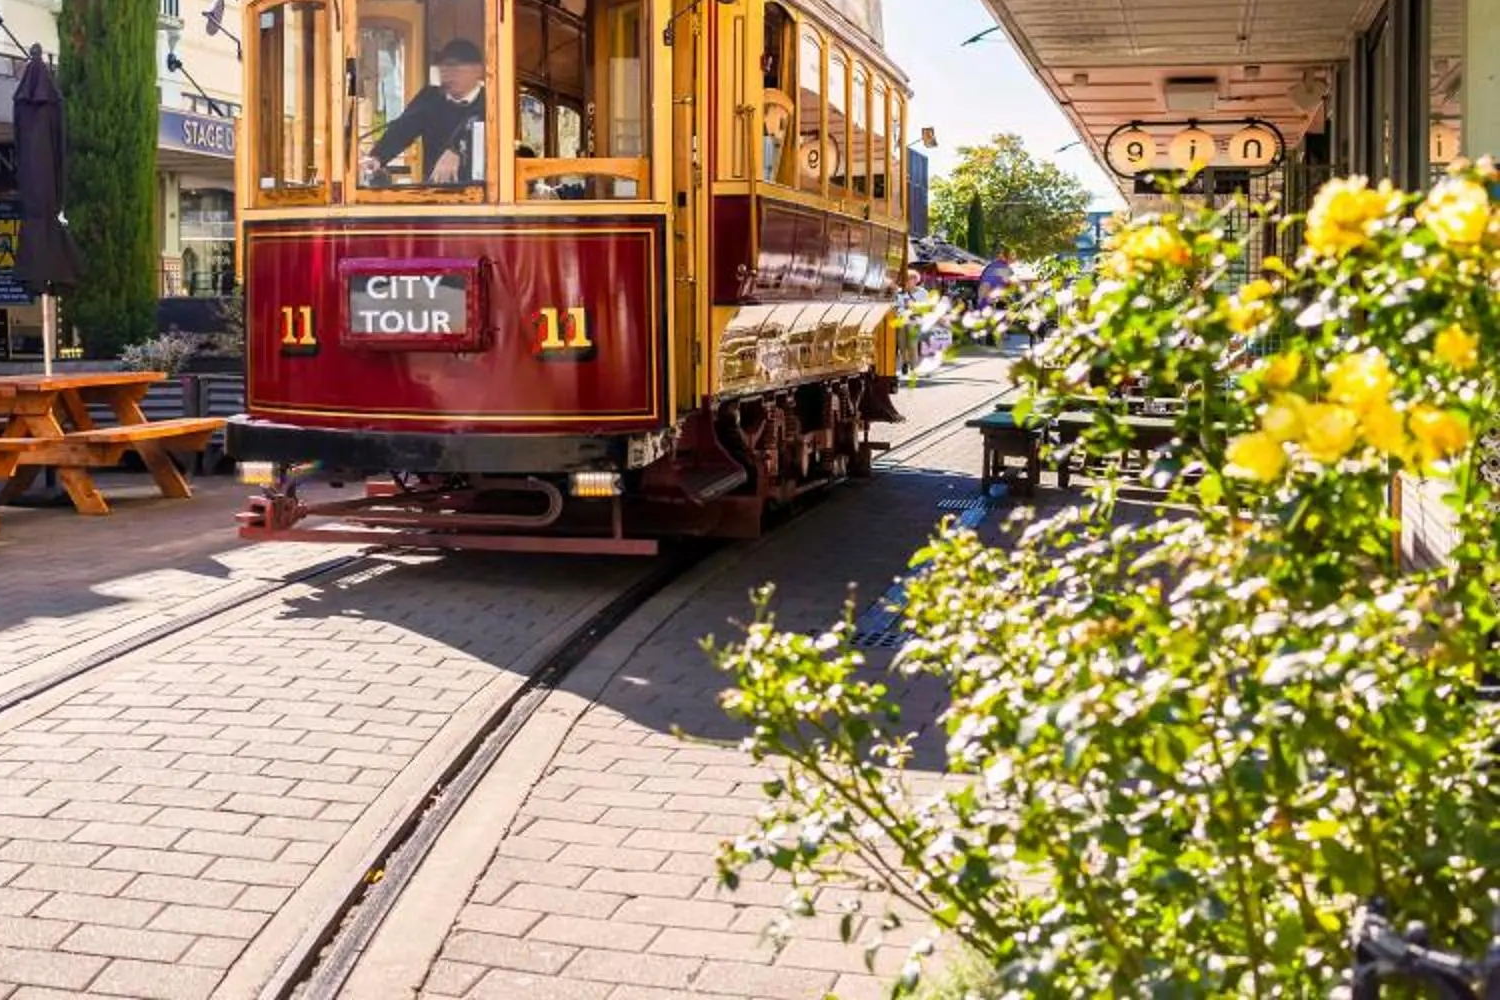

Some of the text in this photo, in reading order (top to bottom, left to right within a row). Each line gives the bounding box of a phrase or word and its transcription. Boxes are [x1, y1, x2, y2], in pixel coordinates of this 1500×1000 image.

[182, 120, 225, 150] STAGE
[366, 275, 443, 300] CITY
[280, 306, 593, 349] 11 11
[358, 310, 452, 334] TOUR
